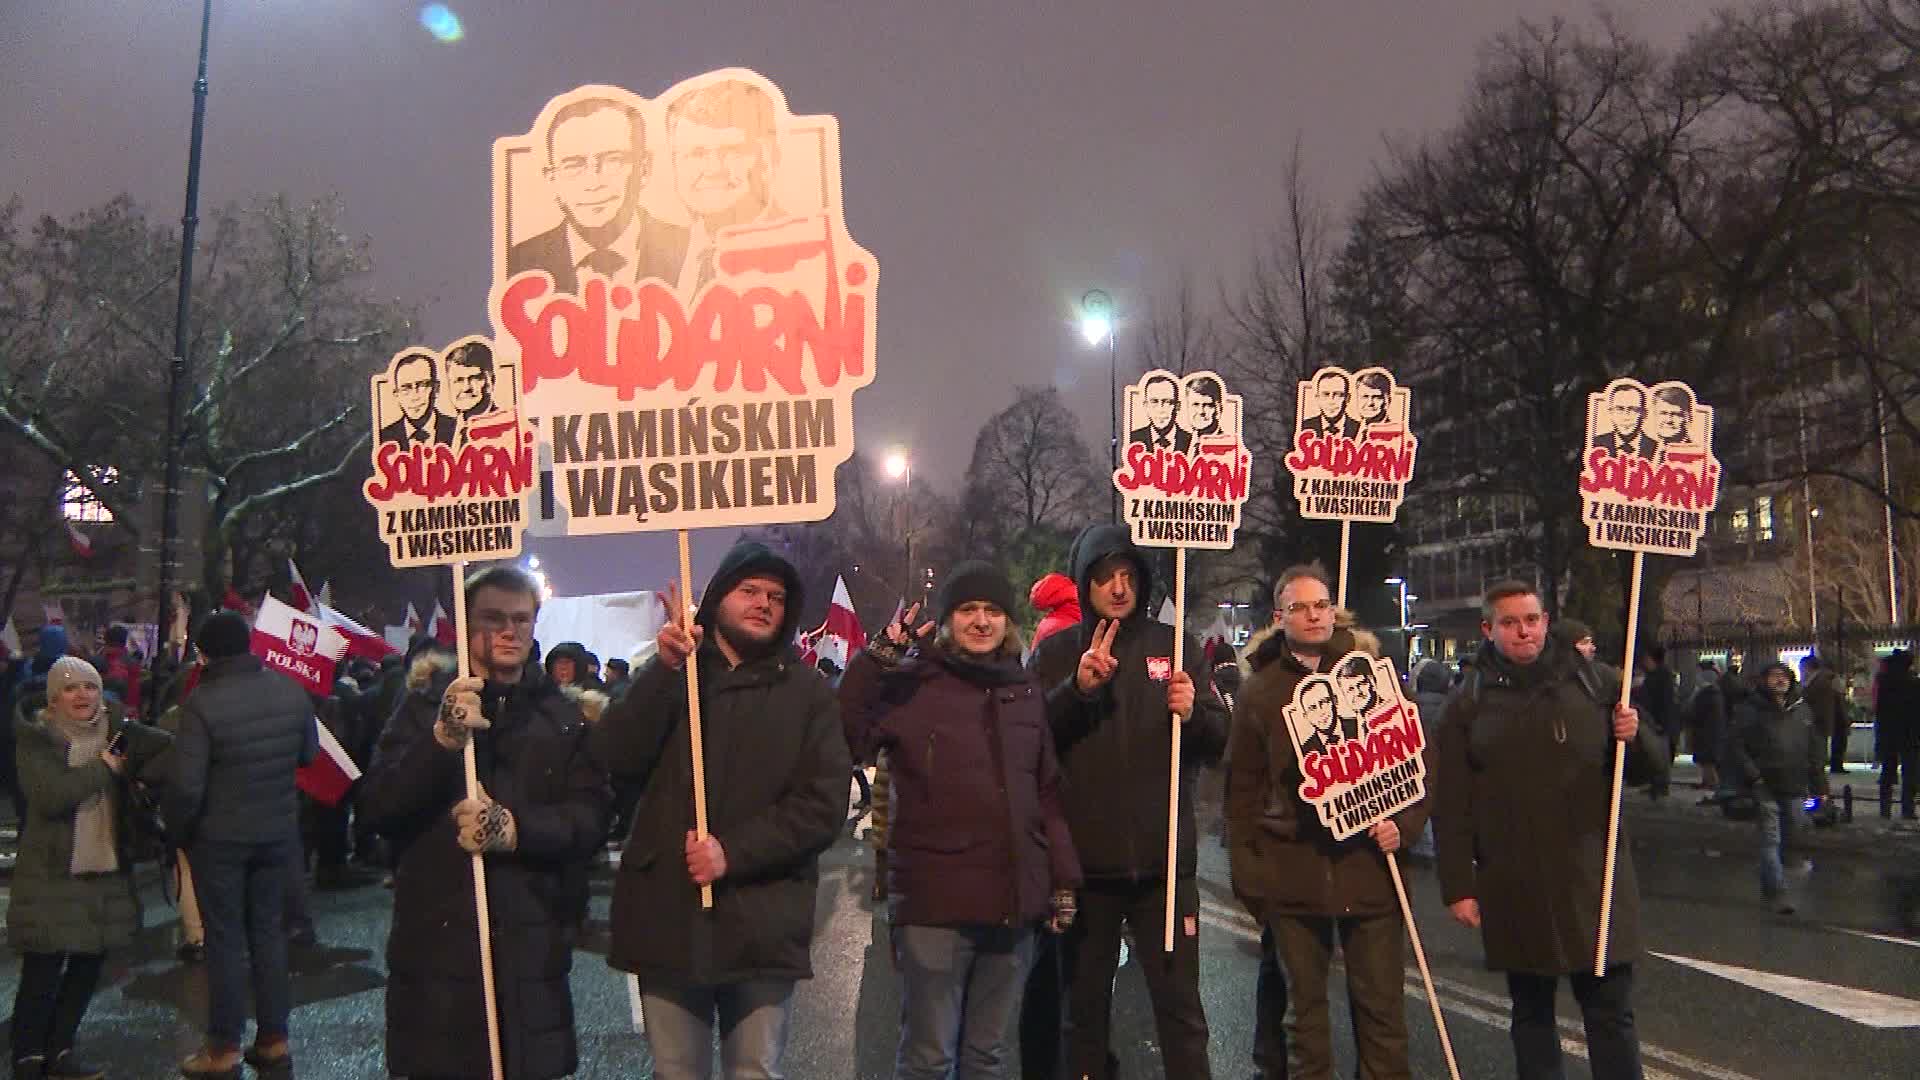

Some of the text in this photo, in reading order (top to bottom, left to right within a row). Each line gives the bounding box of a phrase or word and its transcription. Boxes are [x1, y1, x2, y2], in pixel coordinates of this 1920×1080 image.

[551, 397, 836, 464] KAMIŃSKIM
[566, 455, 818, 523] WĄSIKIEM
[1300, 478, 1399, 500] Z KAMIŃSKIM
[386, 499, 520, 535] Z KAMIŃSKIM
[1131, 498, 1235, 523] Z KAMIŃSKIM
[1305, 496, 1391, 517] I WĄSIKIEM
[1590, 501, 1600, 519] Z
[1138, 520, 1228, 543] I WĄSIKIEM
[1596, 522, 1603, 540] I
[397, 526, 513, 560] I WĄSIKIEM
[265, 648, 321, 683] POLSKA
[1323, 801, 1333, 819] Z
[1335, 816, 1344, 833] I
